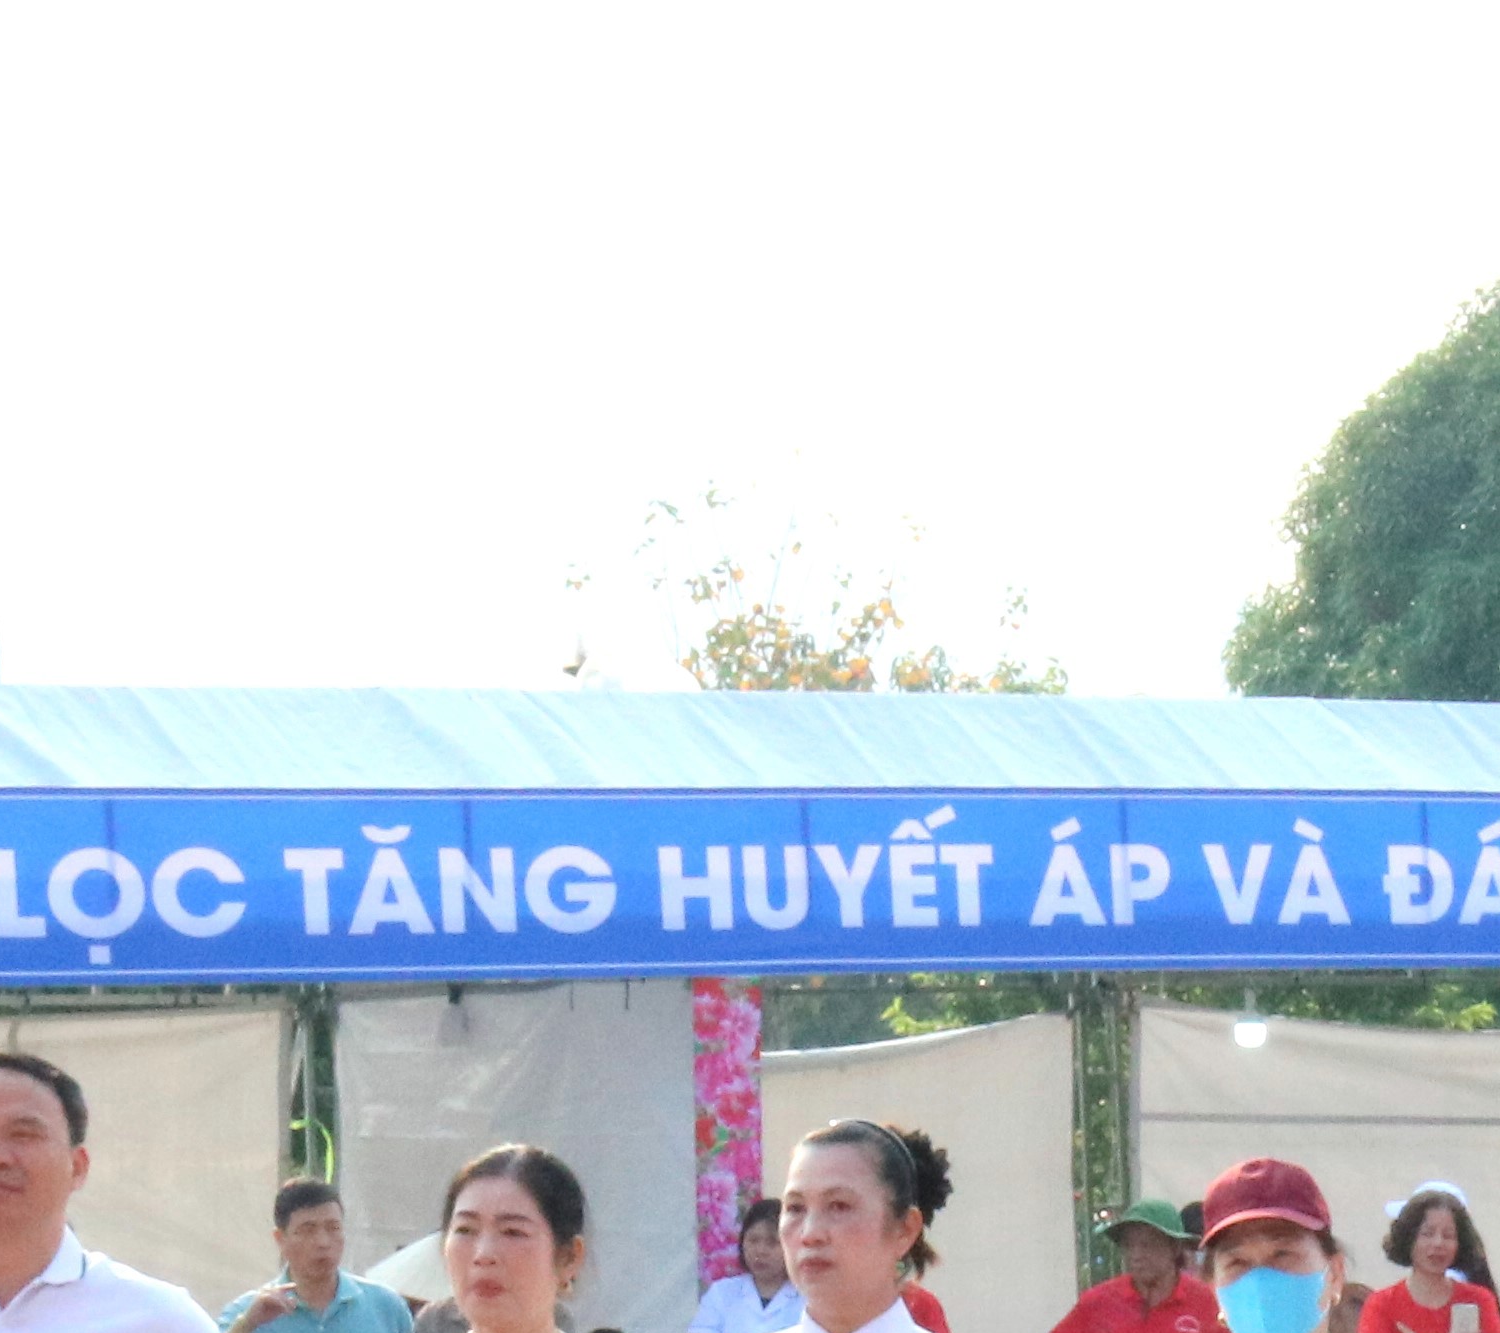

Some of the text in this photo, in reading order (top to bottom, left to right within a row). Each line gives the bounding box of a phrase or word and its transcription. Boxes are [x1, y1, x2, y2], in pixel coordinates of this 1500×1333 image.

[282, 824, 617, 935] TĂNG
[657, 804, 994, 930] HUYẾT
[1031, 816, 1171, 926] ÁP
[1201, 817, 1351, 925] VÀ
